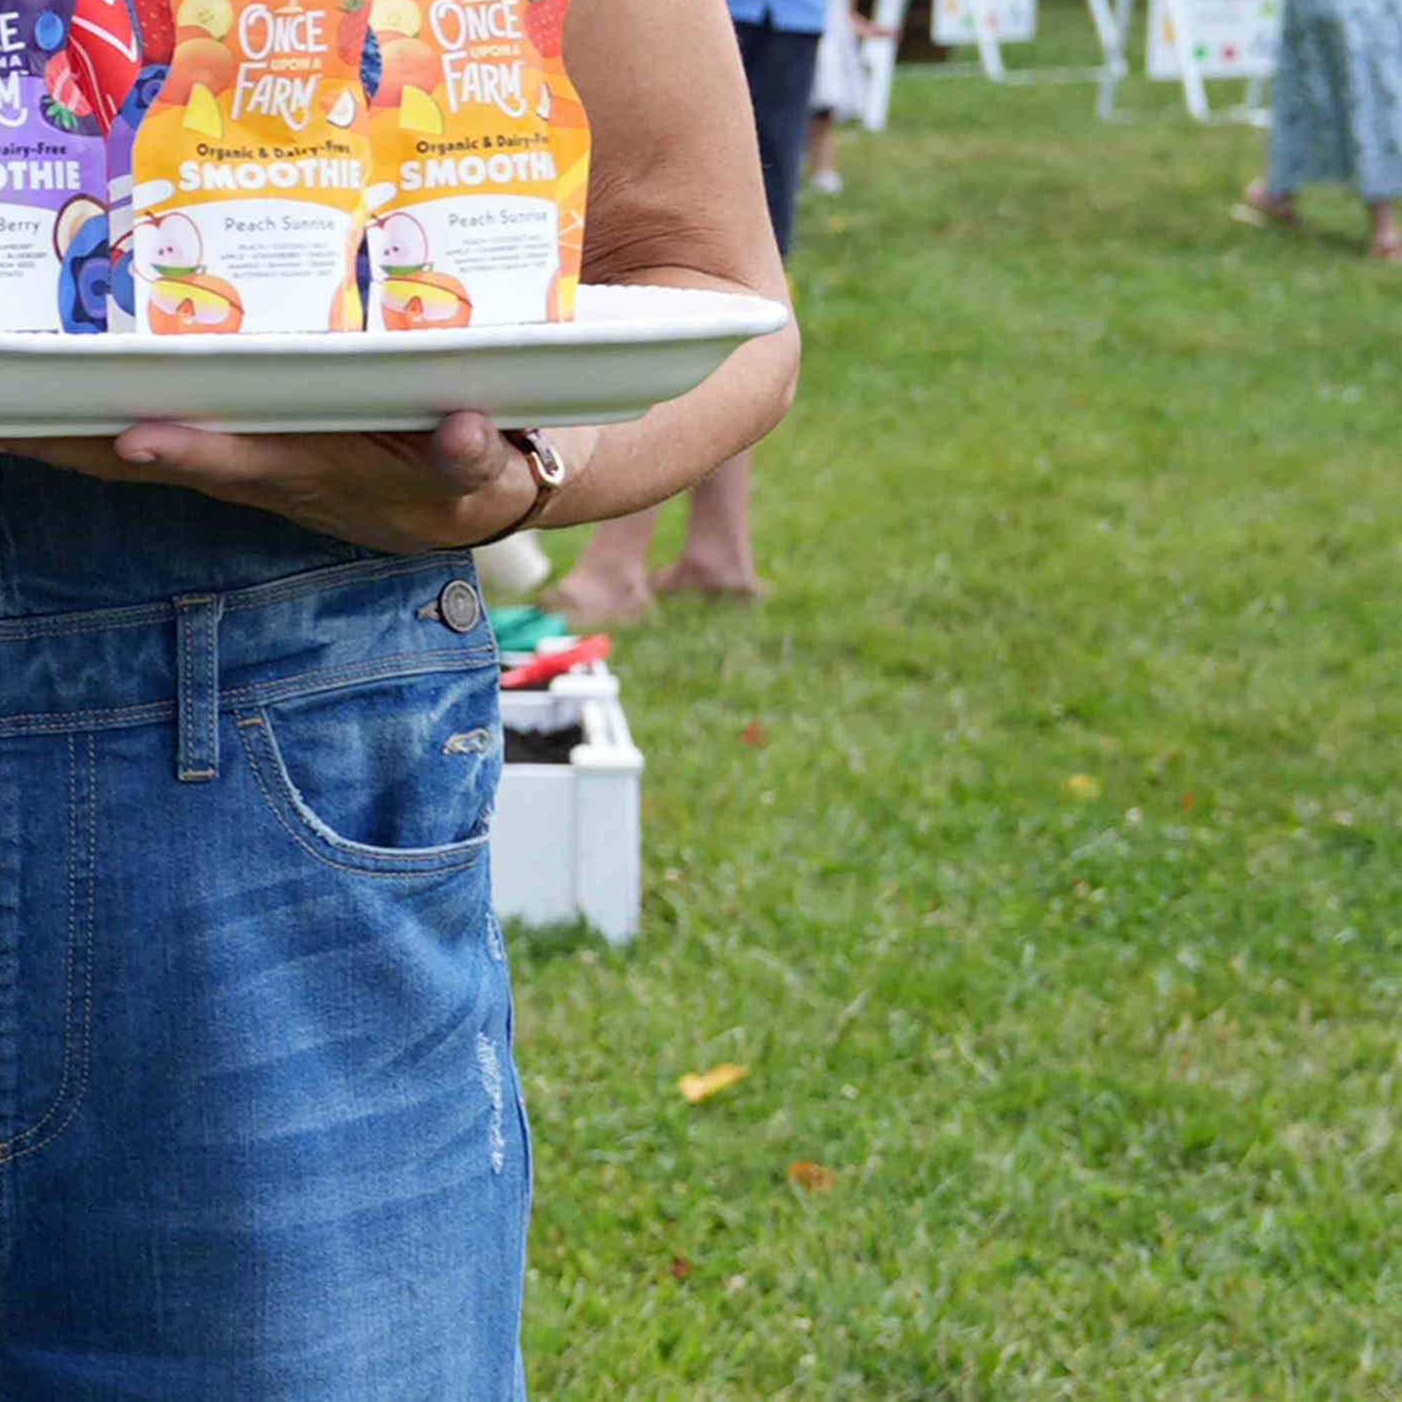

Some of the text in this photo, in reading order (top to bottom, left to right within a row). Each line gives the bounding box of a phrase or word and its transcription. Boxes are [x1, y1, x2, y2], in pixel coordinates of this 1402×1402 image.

[239, 3, 328, 60] ONCE
[8, 55, 23, 68] A
[197, 143, 254, 160] Organic
[259, 144, 269, 158] &
[416, 137, 479, 155] Organic
[483, 136, 493, 149] &
[399, 151, 557, 192] SMOOTH
[224, 216, 276, 232] Peach
[448, 209, 497, 228] Peach
